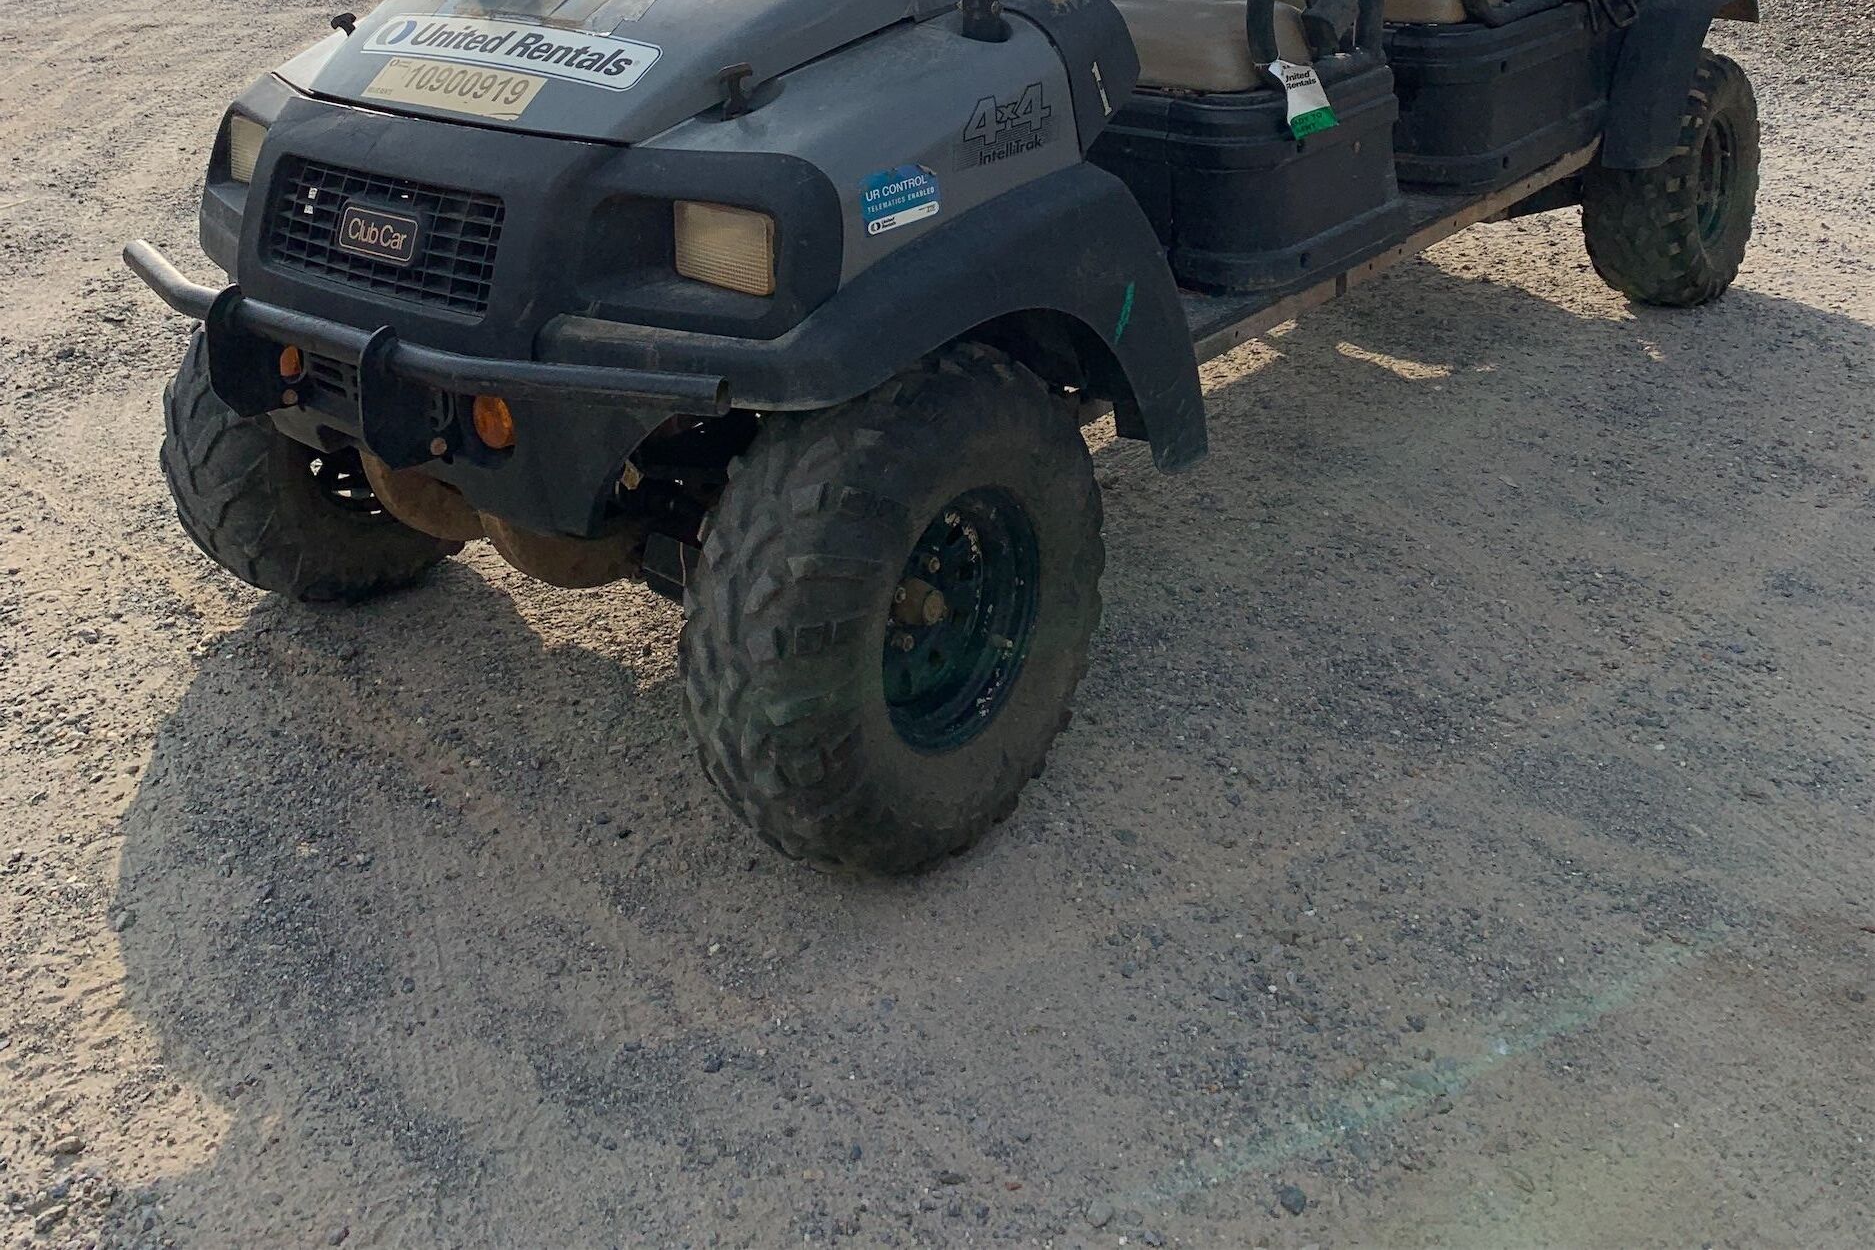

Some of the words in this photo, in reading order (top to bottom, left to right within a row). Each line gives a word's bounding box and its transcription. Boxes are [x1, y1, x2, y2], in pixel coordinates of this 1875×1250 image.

[410, 21, 515, 54] United
[504, 31, 635, 77] Rentals
[403, 63, 530, 106] 10900919
[1286, 77, 1317, 90] Rentals
[963, 82, 1051, 146] 4x4
[978, 134, 1043, 166] IntelliTrak
[865, 189, 881, 202] UR
[881, 174, 928, 197] CONTROL
[867, 195, 906, 213] TELEMATICS
[907, 186, 935, 201] ENABLED
[348, 217, 379, 245] Club
[380, 224, 408, 251] Car
